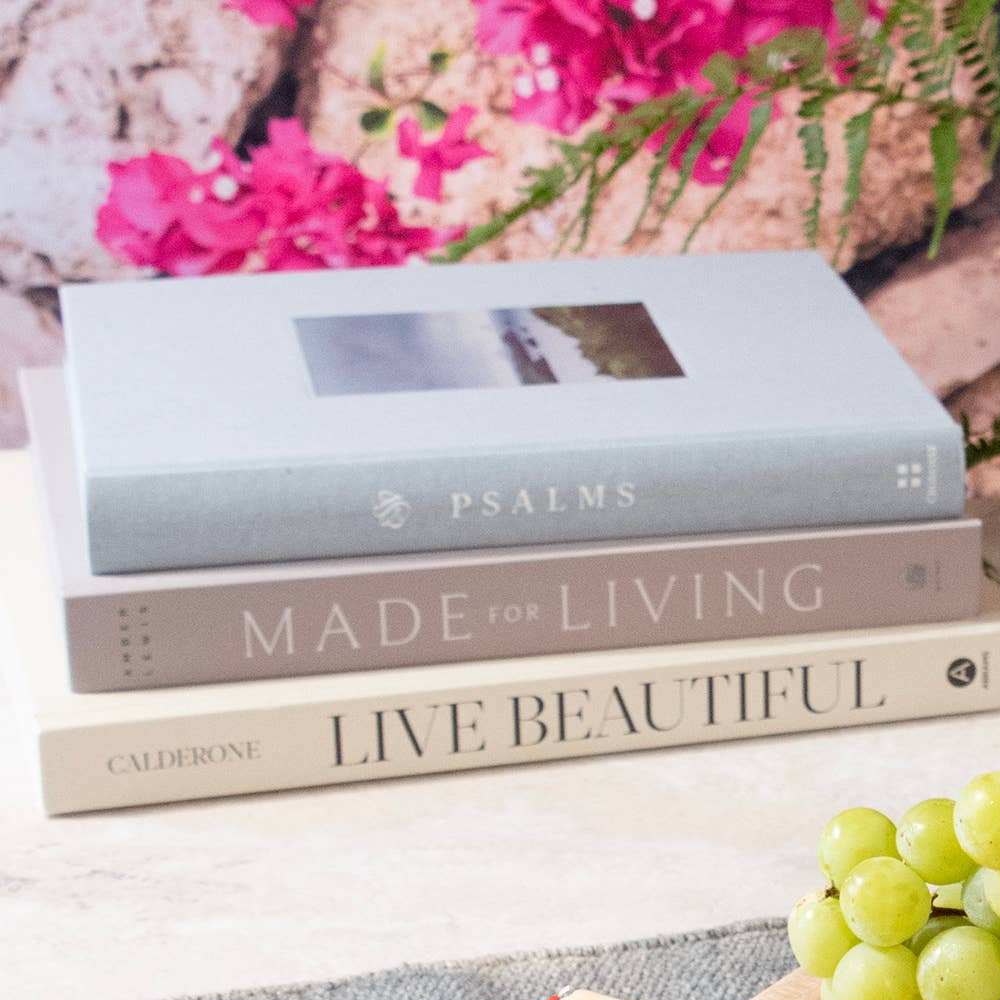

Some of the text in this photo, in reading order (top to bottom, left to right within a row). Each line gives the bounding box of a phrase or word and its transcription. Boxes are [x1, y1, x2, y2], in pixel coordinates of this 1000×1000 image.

[450, 481, 636, 519] PSALMS
[242, 563, 825, 659] MADE FOR LIVING
[107, 658, 887, 776] CALDERONE LIVE BEAUTIFUL
